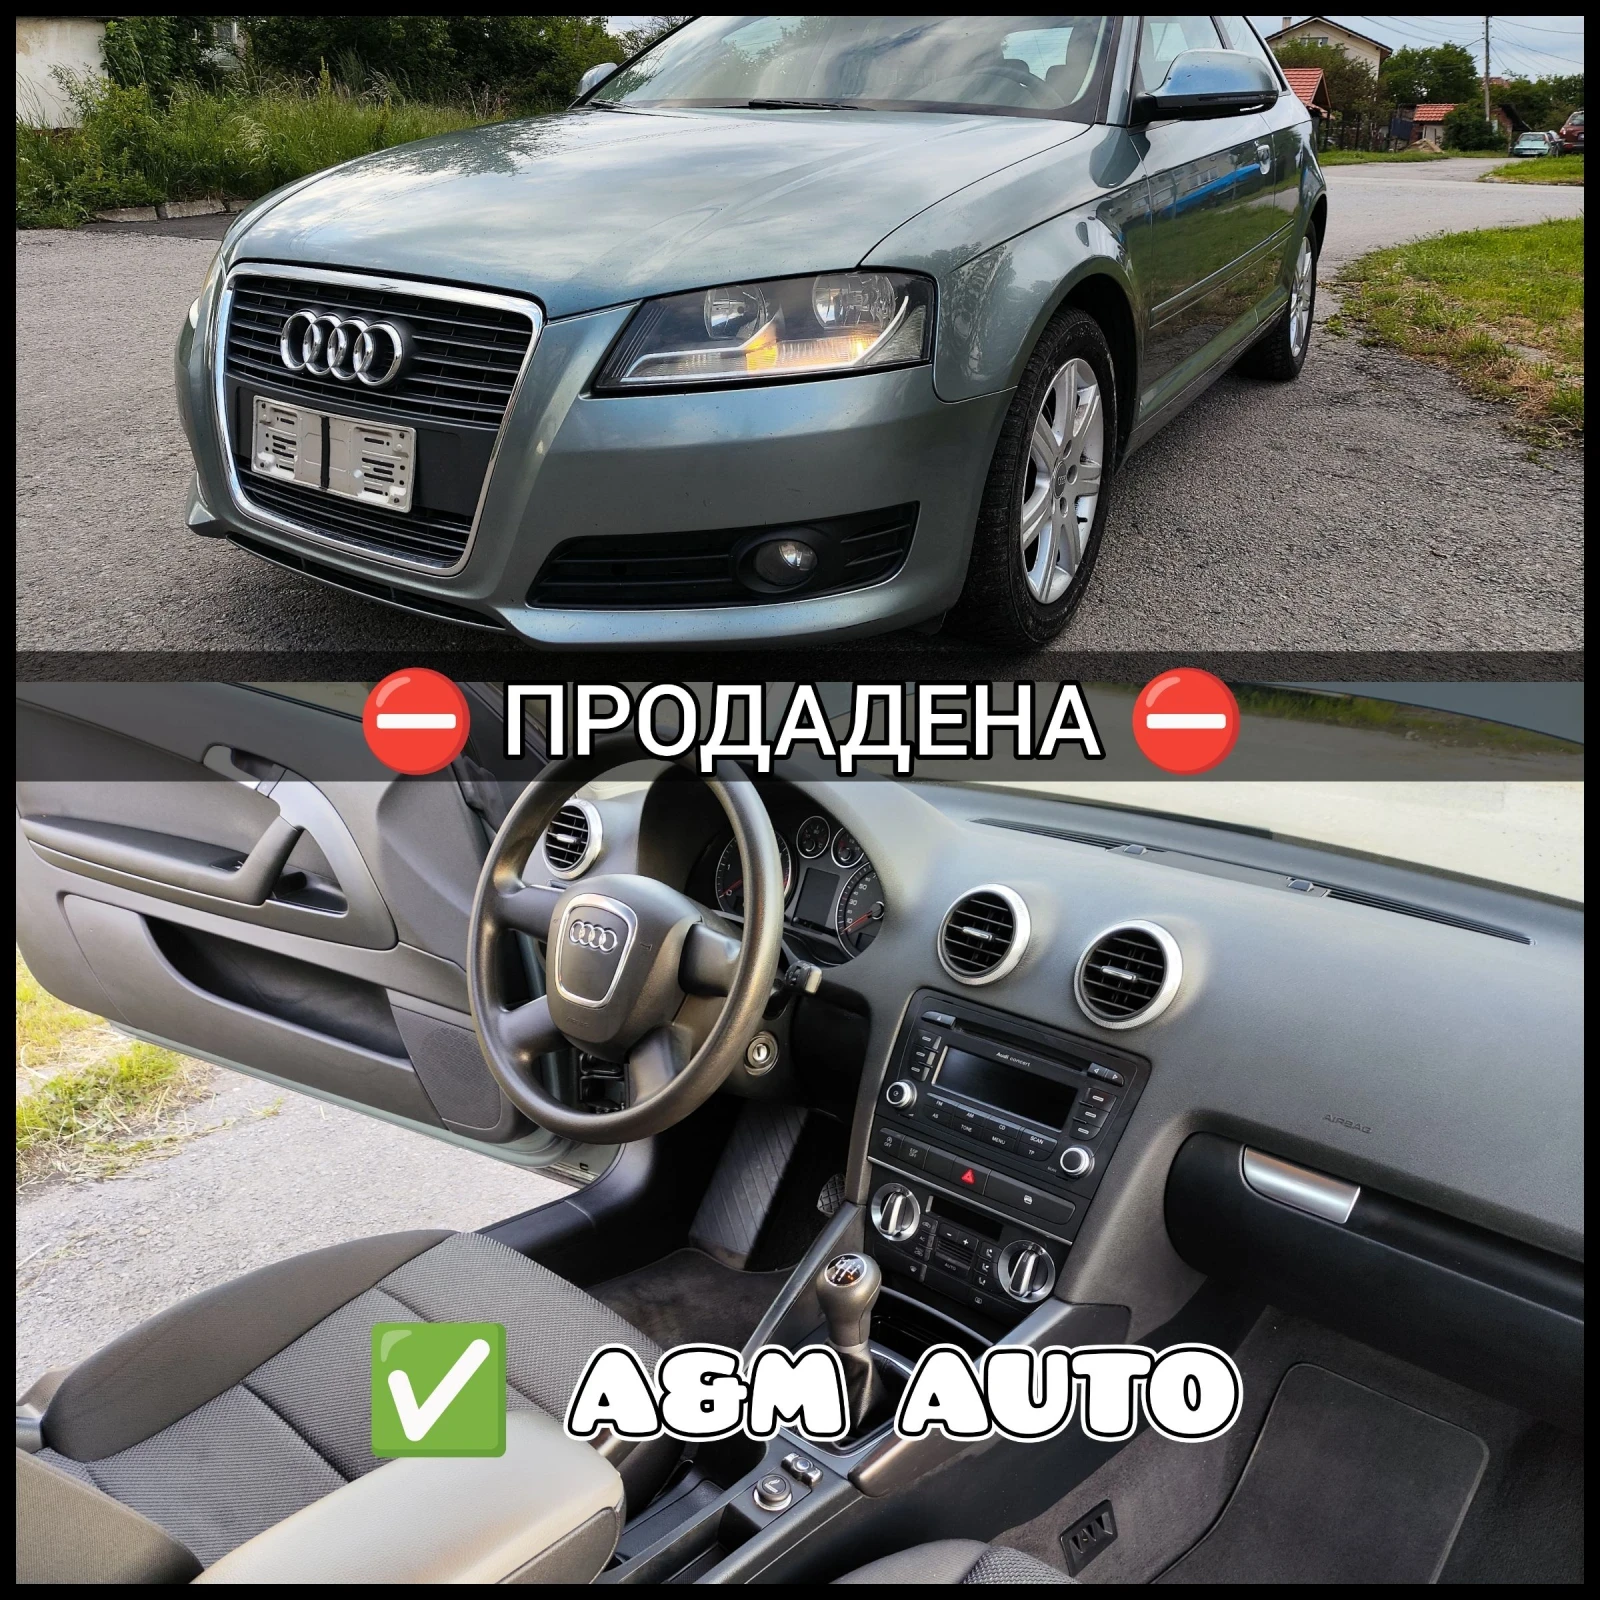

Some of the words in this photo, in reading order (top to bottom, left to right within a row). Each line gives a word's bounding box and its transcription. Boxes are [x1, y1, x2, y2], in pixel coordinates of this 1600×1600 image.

[996, 1052, 1009, 1060] Audi
[1009, 1056, 1031, 1067] concert
[961, 1124, 972, 1132] TONE
[1322, 1114, 1372, 1134] AIRBAG
[991, 1136, 1005, 1144] MENU
[1030, 1135, 1044, 1144] SCAN
[944, 1262, 956, 1270] AUTO
